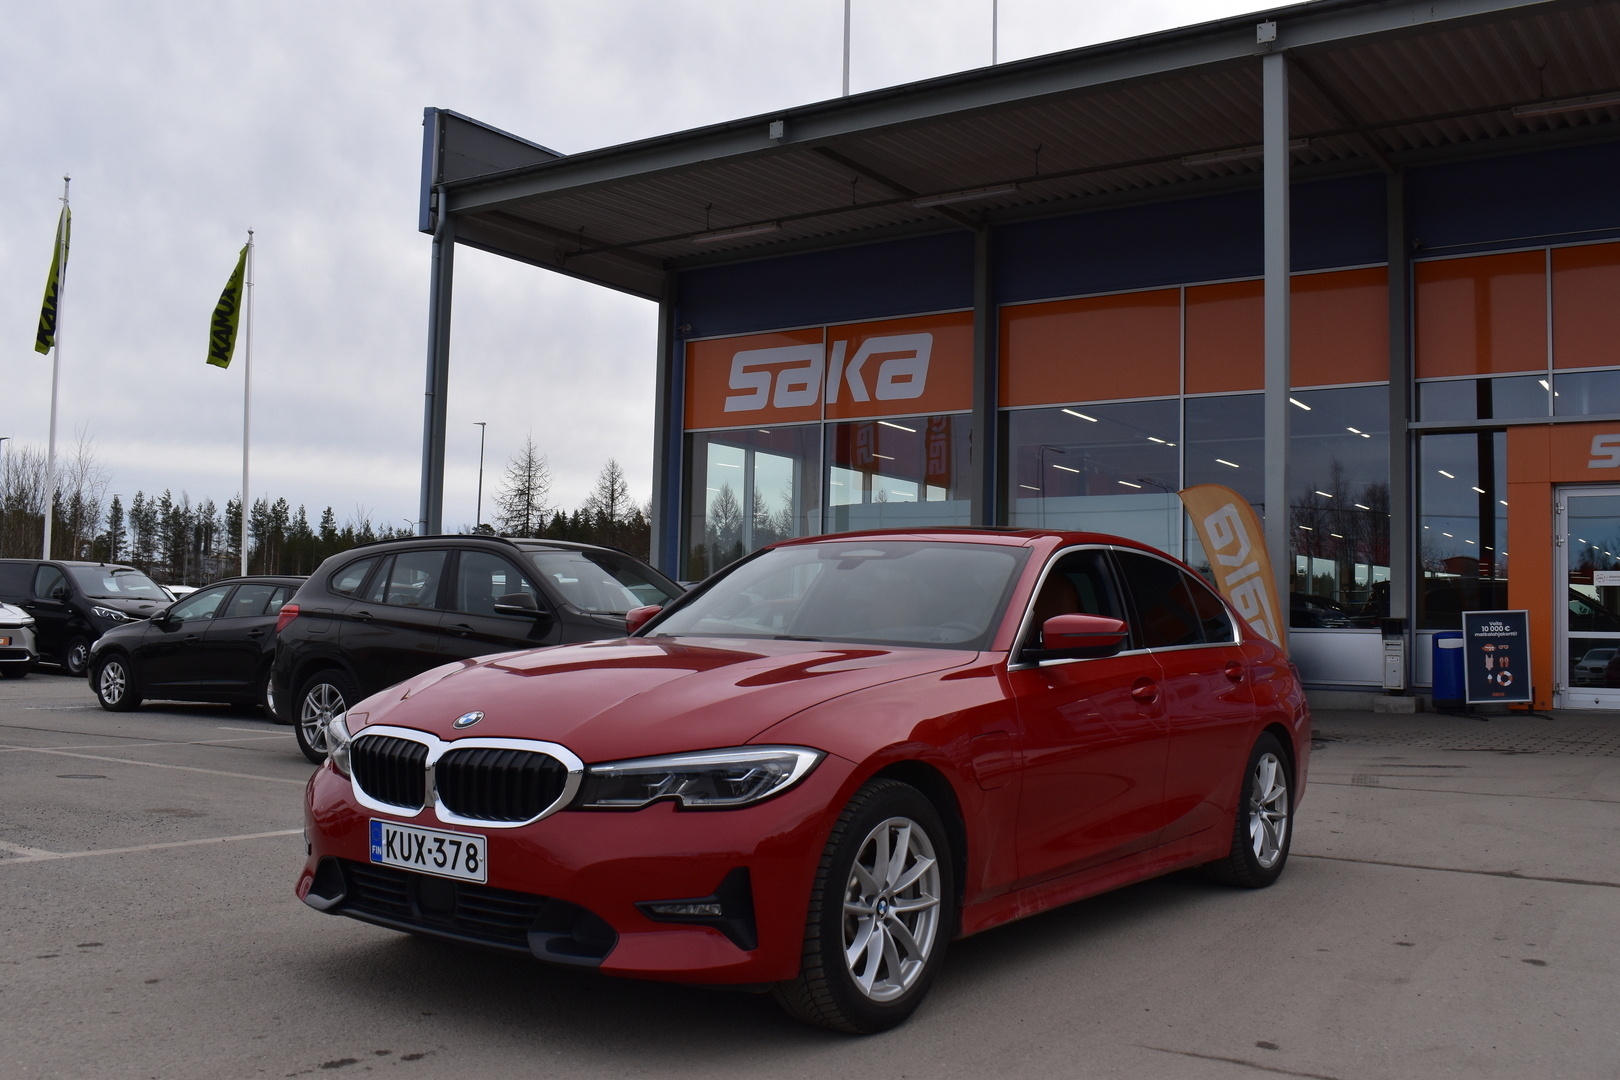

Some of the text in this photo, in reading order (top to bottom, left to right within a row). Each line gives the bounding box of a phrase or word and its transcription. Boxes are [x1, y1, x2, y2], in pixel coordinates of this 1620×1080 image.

[211, 287, 237, 363] KAMUX
[372, 845, 382, 855] FIN
[386, 829, 479, 873] KUX-378
